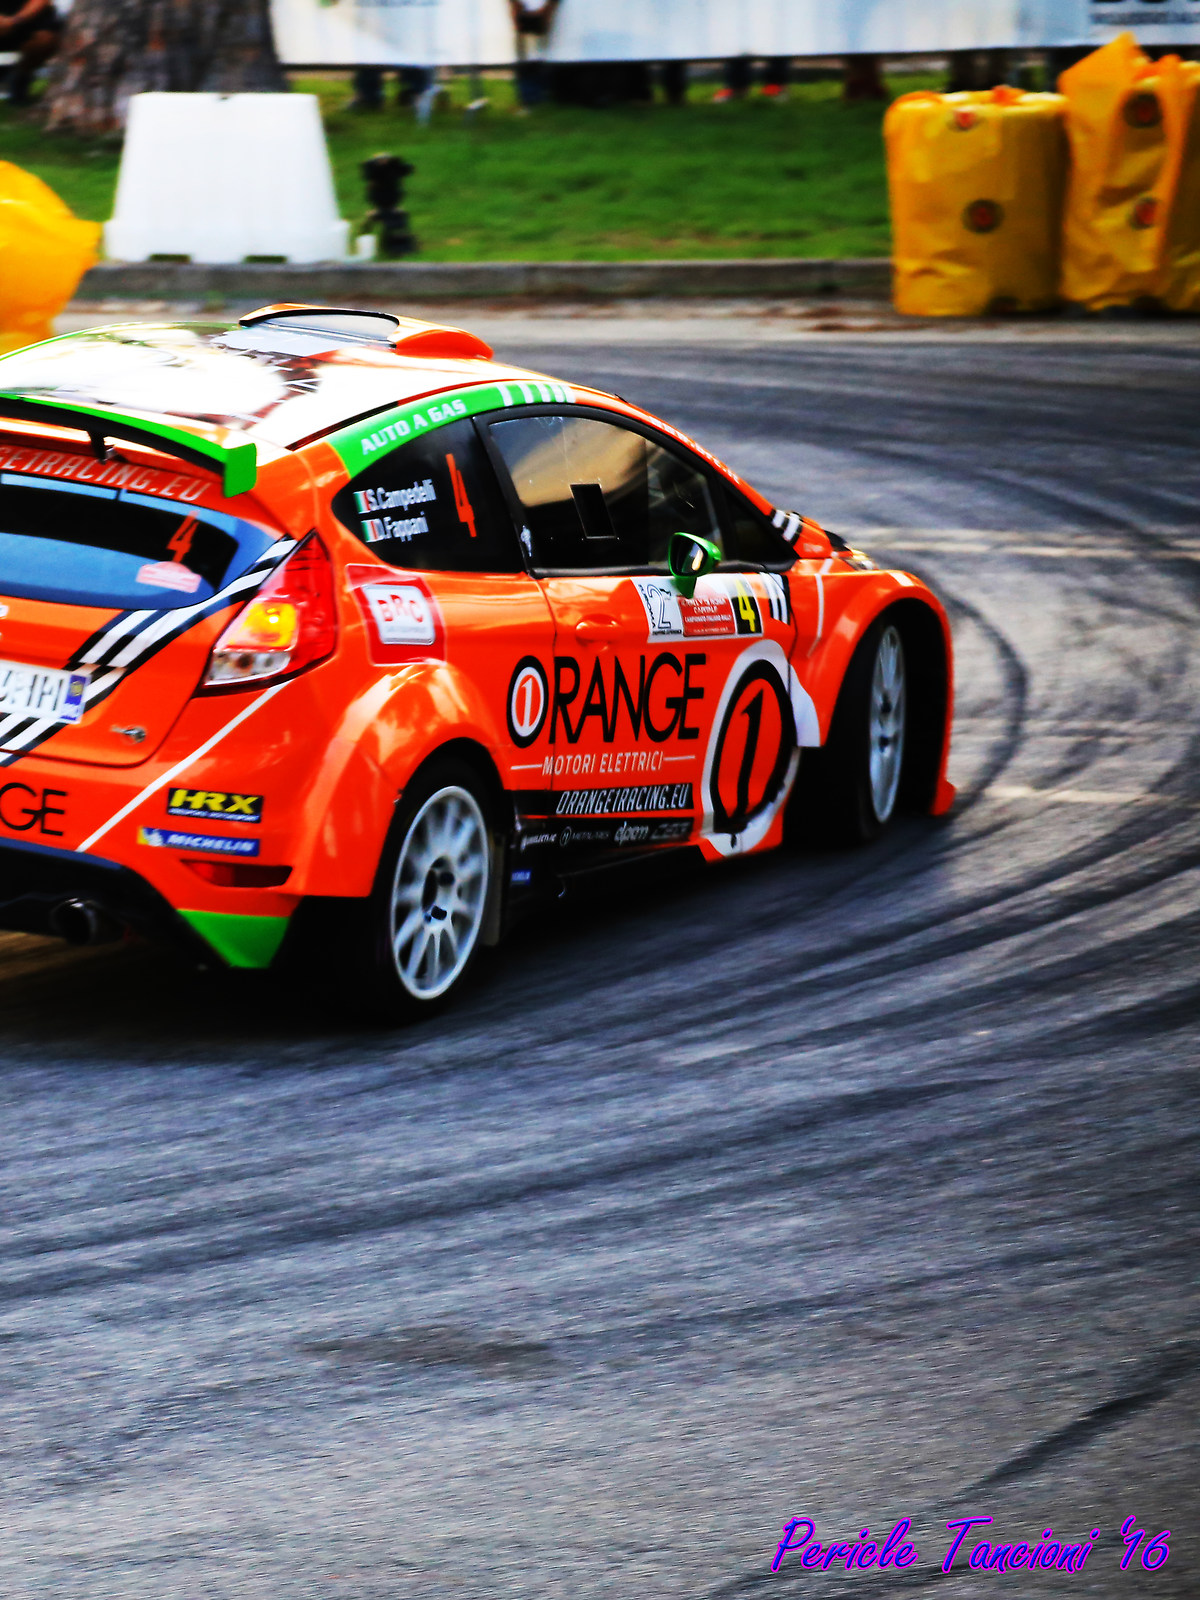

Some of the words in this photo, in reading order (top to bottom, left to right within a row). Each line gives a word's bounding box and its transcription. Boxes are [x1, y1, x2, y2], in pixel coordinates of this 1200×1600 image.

[359, 421, 411, 455] AUTO
[412, 414, 428, 430] A
[427, 399, 467, 422] GAS
[445, 453, 477, 538] 4
[166, 510, 201, 562] 4
[735, 579, 756, 633] 4
[542, 754, 596, 776] MOTORI
[600, 751, 664, 774] ELETTRICI
[170, 789, 259, 814] HRX
[555, 783, 690, 816] ORANGE1RACING.EU
[166, 834, 256, 852] MICHELIN
